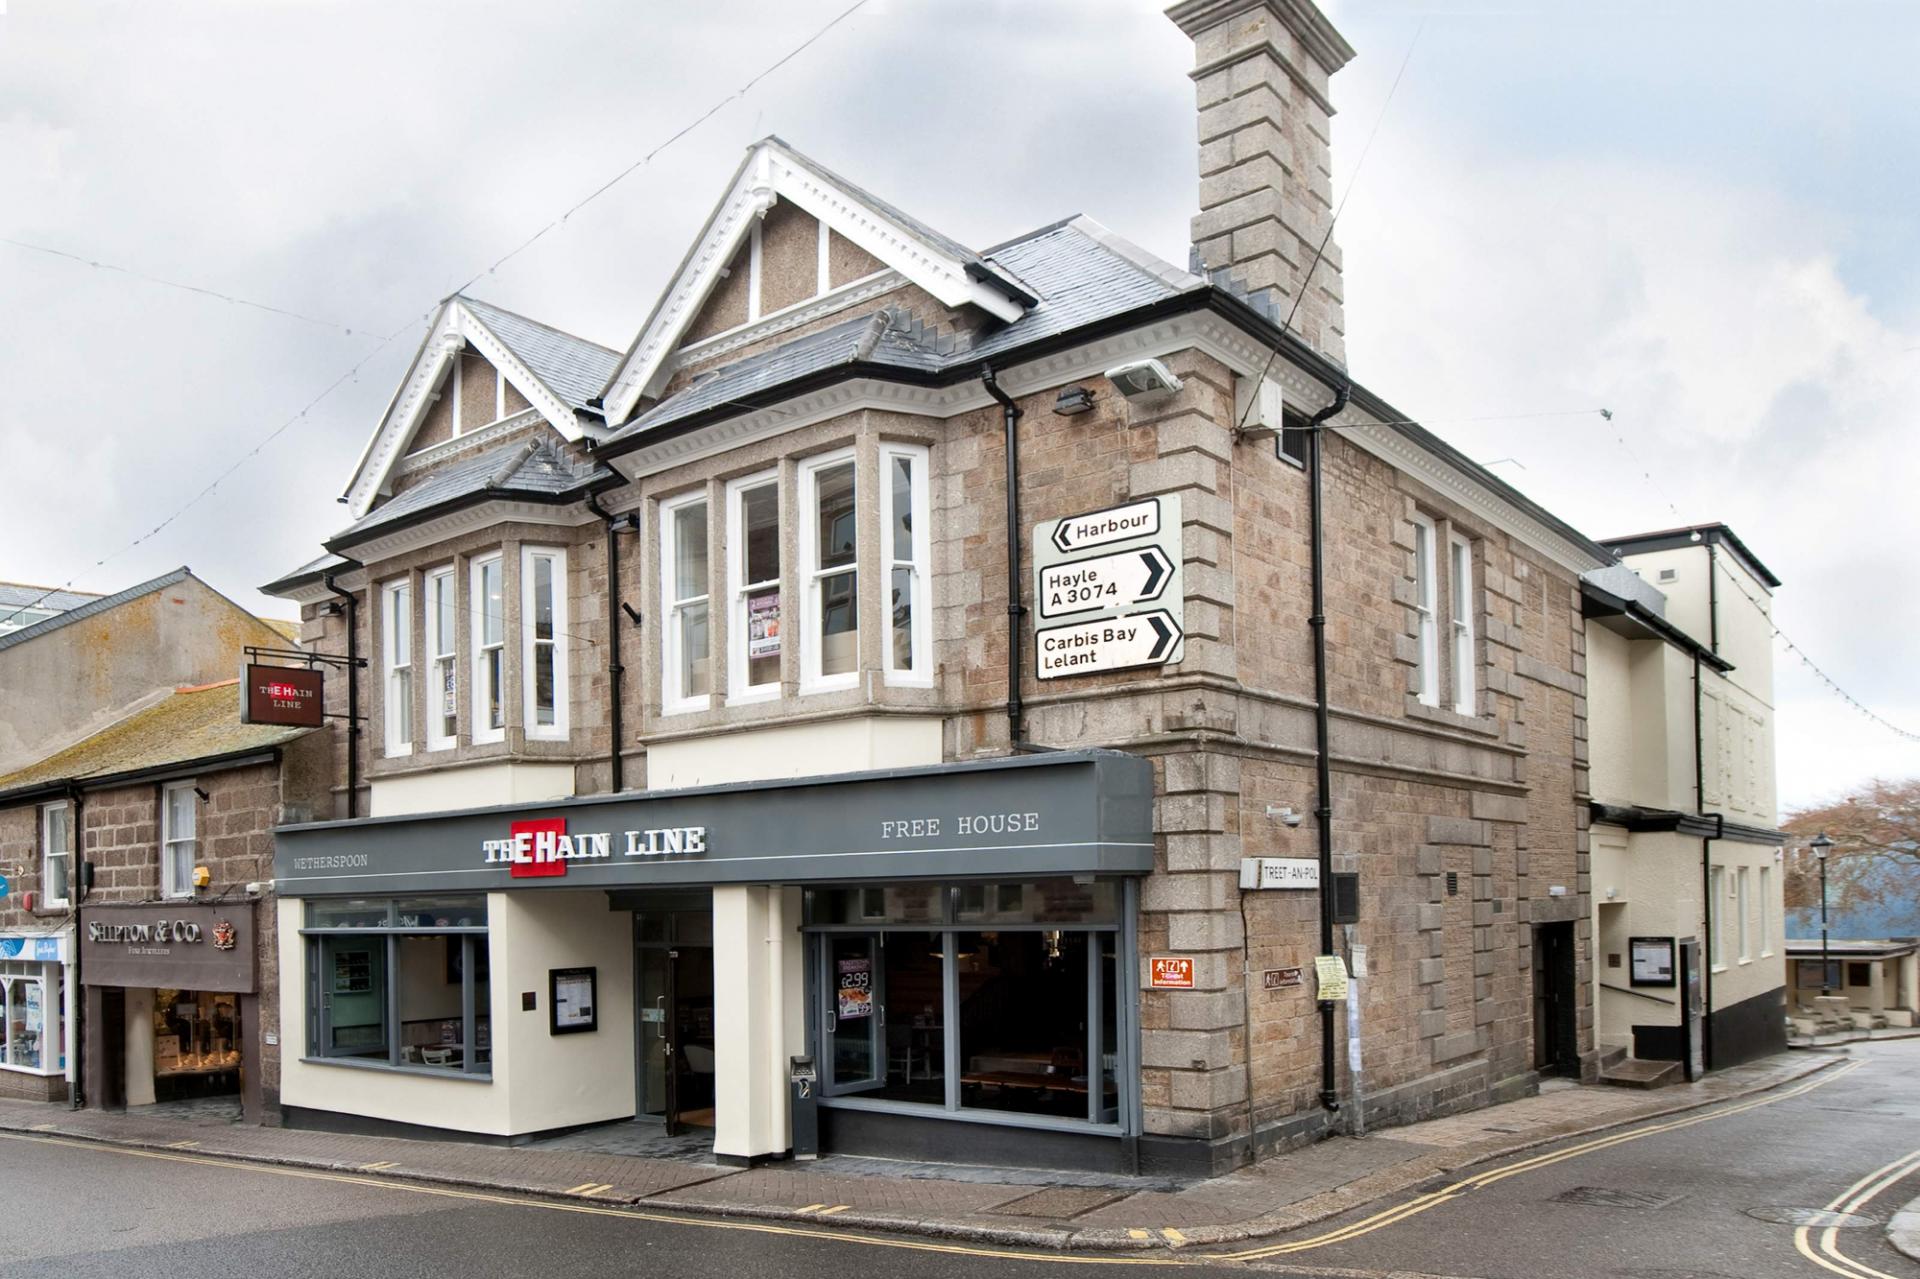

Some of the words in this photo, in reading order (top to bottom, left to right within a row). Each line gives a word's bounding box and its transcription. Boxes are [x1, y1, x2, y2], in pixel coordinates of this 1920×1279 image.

[1077, 514, 1149, 539] Harbour
[1050, 570, 1097, 588] Hayle
[1051, 593, 1062, 606] A
[1067, 582, 1118, 603] 3074
[1044, 632, 1099, 652] Carbis
[1103, 628, 1137, 643] Bay
[1044, 650, 1097, 669] Lelant
[273, 700, 302, 709] LINE
[881, 818, 940, 839] FREE
[957, 812, 1039, 835] HOUSE
[482, 832, 533, 864] THE
[535, 831, 611, 864] HAIN
[624, 826, 706, 856] LINE
[294, 854, 368, 870] WETHERSPOON
[154, 920, 169, 943] &
